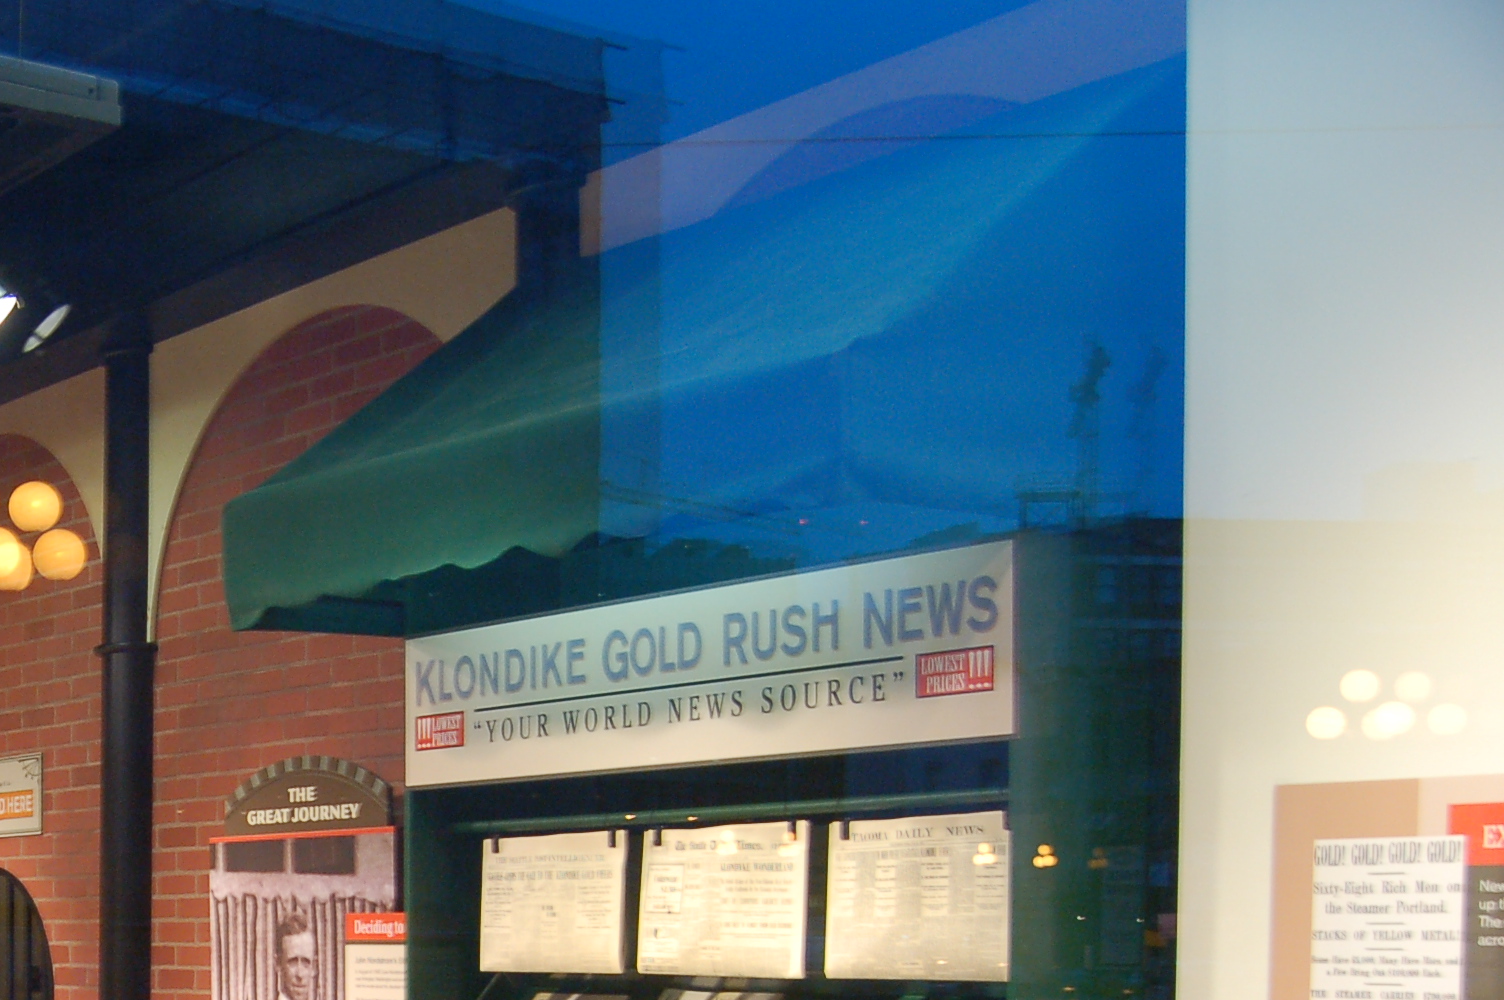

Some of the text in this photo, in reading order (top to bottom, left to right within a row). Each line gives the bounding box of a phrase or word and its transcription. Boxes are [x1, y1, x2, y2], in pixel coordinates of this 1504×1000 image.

[416, 576, 998, 706] KLONDIKE GOLD RUSH NEWS
[921, 654, 965, 675] LOWEST
[926, 673, 965, 694] PRICES
[563, 702, 652, 735] WORLD
[668, 695, 744, 725] NEWS
[7, 794, 33, 814] HERE
[288, 787, 317, 803] THE
[247, 803, 361, 826] GREAT JOURNEY
[896, 827, 934, 840] DAILY
[946, 825, 985, 837] NEWS
[1314, 841, 1462, 867] GOLD! GOLD! GOLD! GOLD!
[1313, 881, 1374, 897] Sixty-Eight
[1382, 881, 1406, 894] Rich
[1415, 881, 1439, 893] Men
[1325, 902, 1342, 914] the
[1347, 902, 1391, 914] Steamer
[354, 919, 406, 938] Deciding to
[1312, 930, 1347, 941] STACKS
[1353, 930, 1366, 941] OF
[1373, 930, 1413, 941] YELLOW
